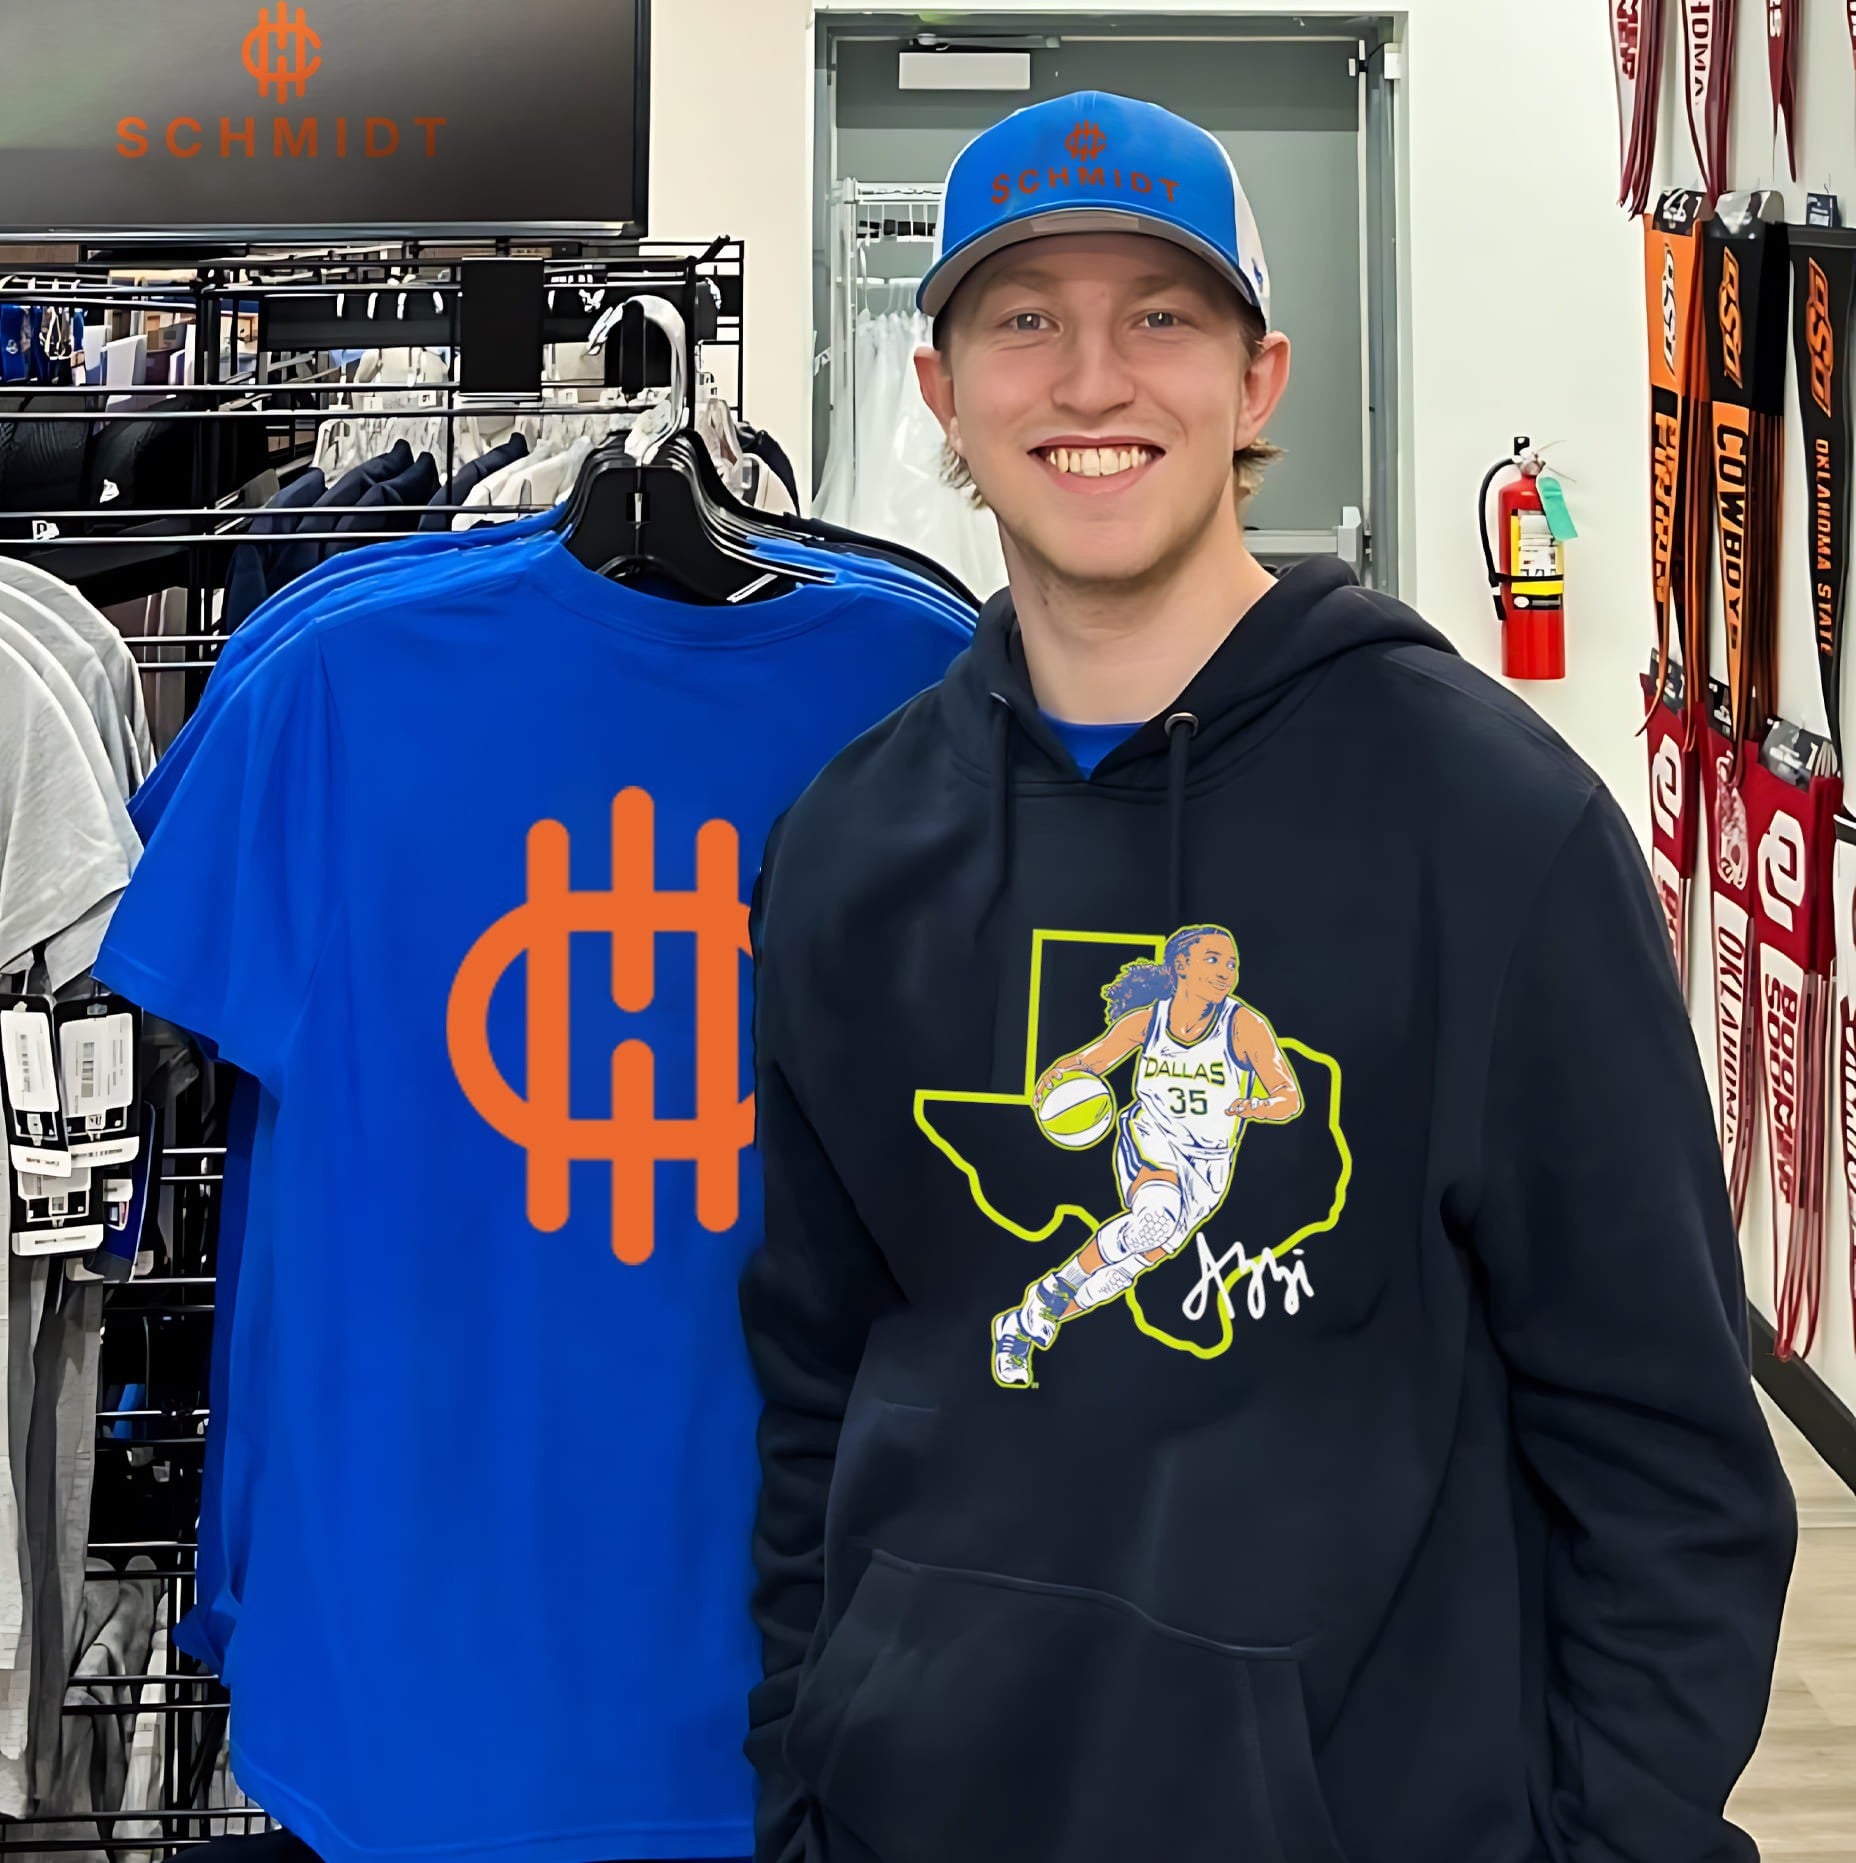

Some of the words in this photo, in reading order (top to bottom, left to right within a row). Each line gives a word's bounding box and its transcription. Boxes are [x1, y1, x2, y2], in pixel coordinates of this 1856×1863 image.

[115, 116, 448, 159] SCHMIDT
[991, 166, 1179, 205] SCHMIDT
[1815, 438, 1832, 570] OKLAHOMA
[1718, 925, 1745, 1144] OKLAHOMA
[1144, 1056, 1226, 1088] DALLAS
[1167, 1086, 1208, 1115] 35
